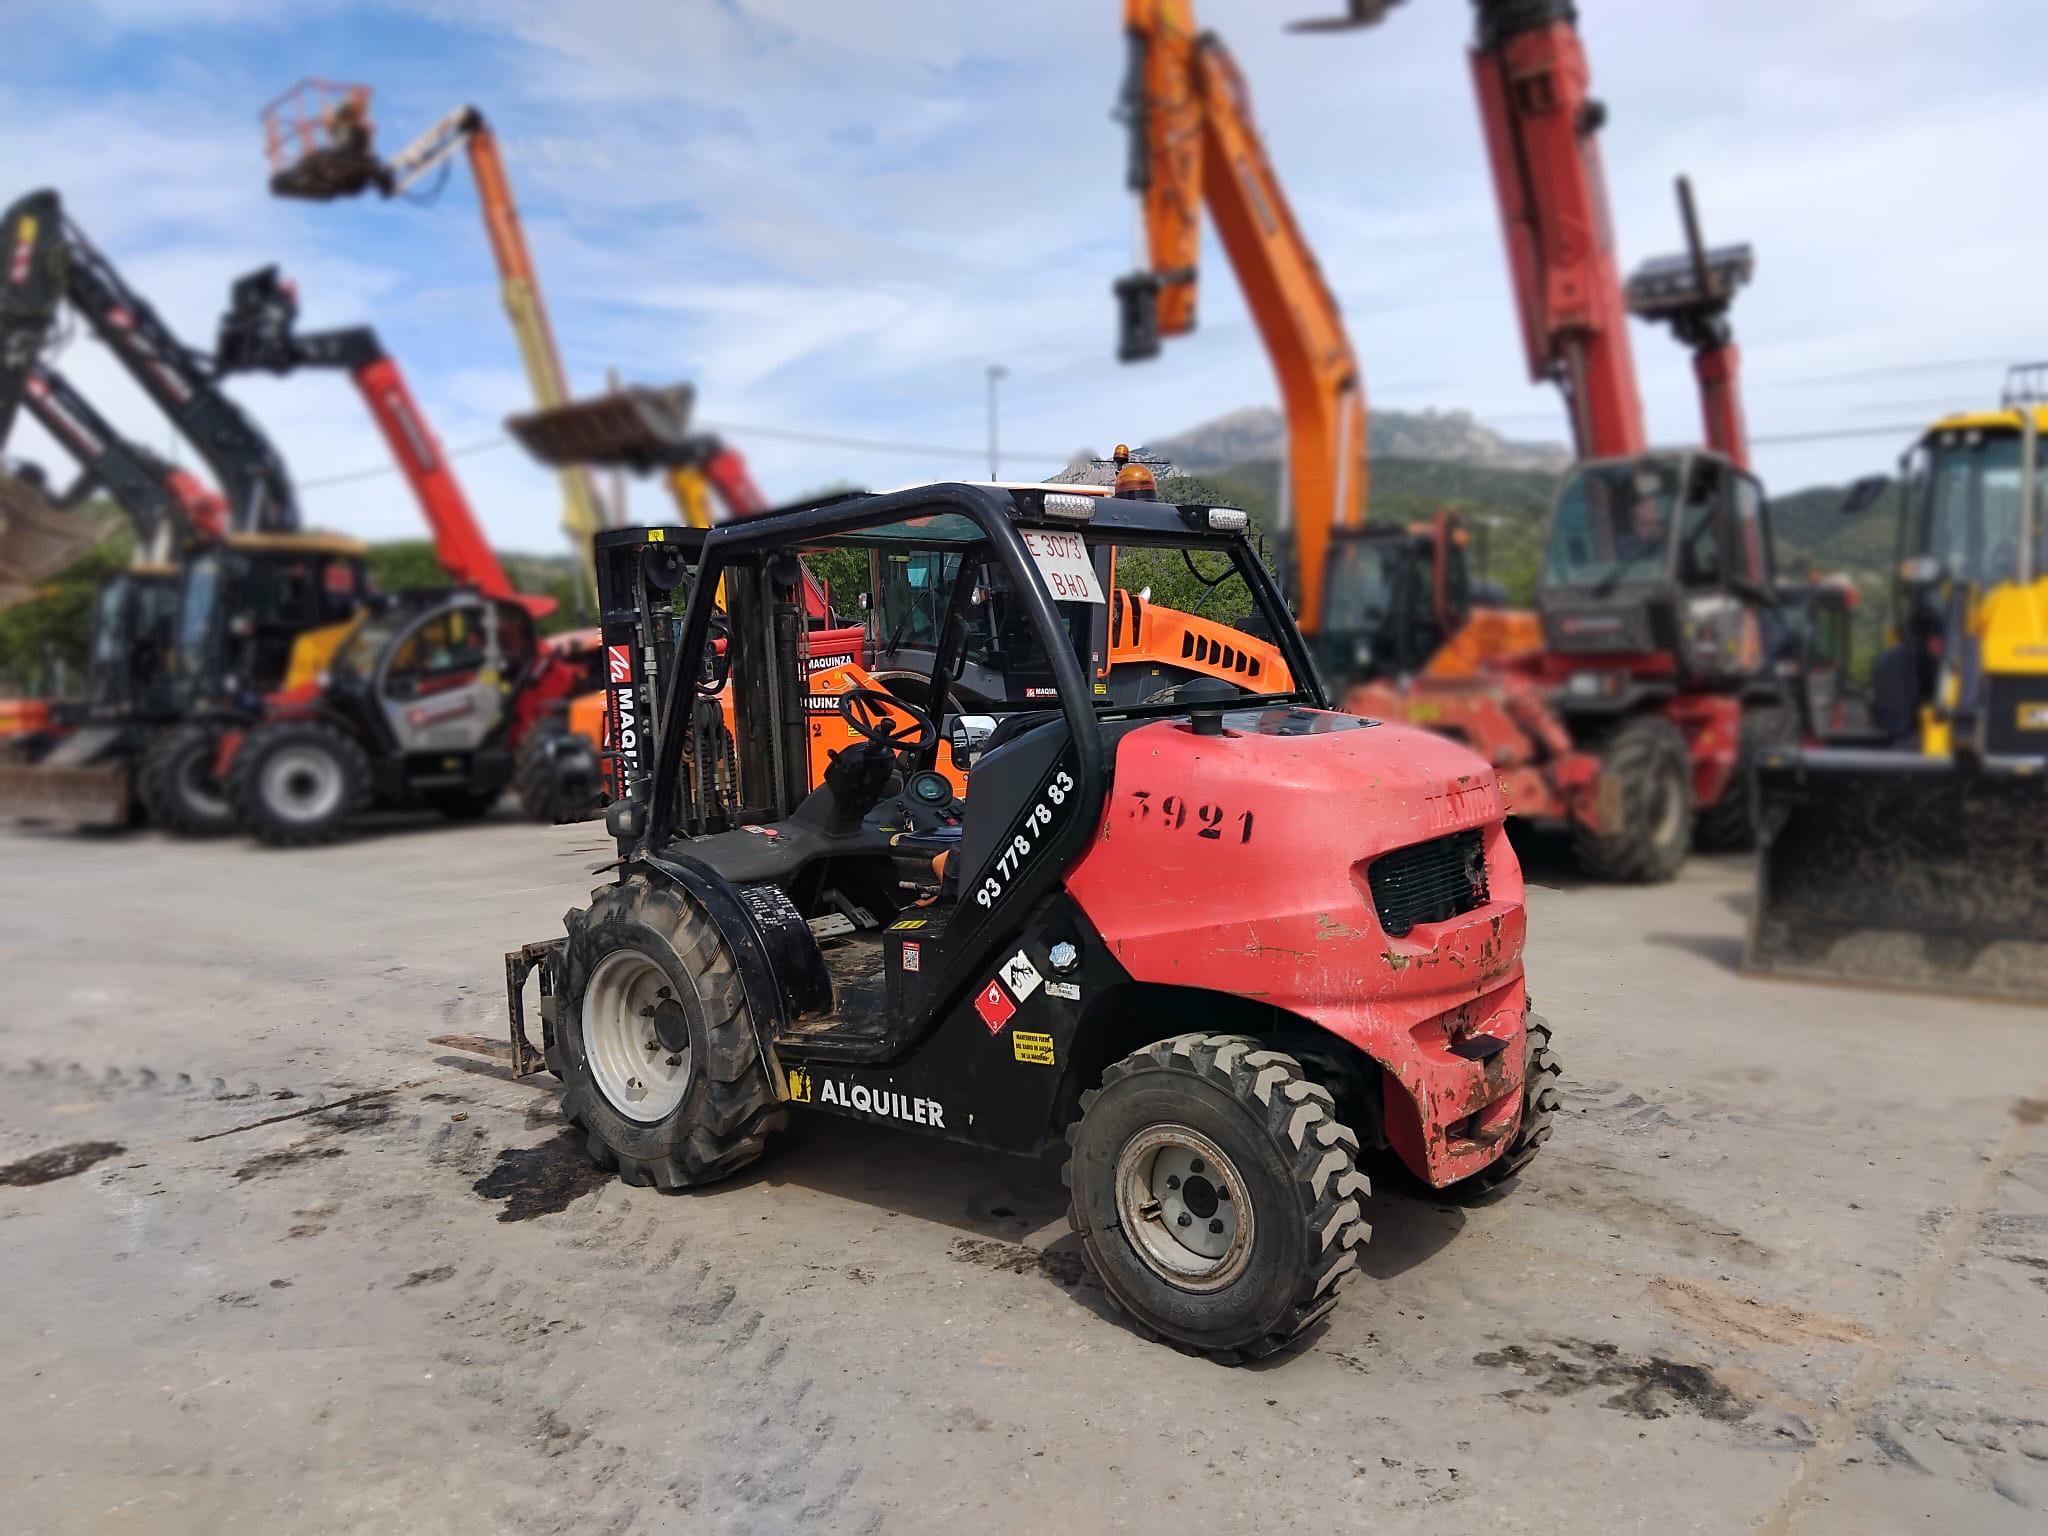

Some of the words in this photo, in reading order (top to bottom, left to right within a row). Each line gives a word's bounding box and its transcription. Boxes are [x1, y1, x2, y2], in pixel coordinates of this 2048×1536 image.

[1024, 533, 1041, 557] E
[1041, 534, 1082, 560] 3073
[976, 877, 1002, 909] 93
[996, 835, 1031, 882] 778
[1025, 803, 1052, 839] 78
[1047, 771, 1074, 805] 83
[992, 1020, 998, 1030] 3
[820, 1079, 946, 1129] ALQUILER
